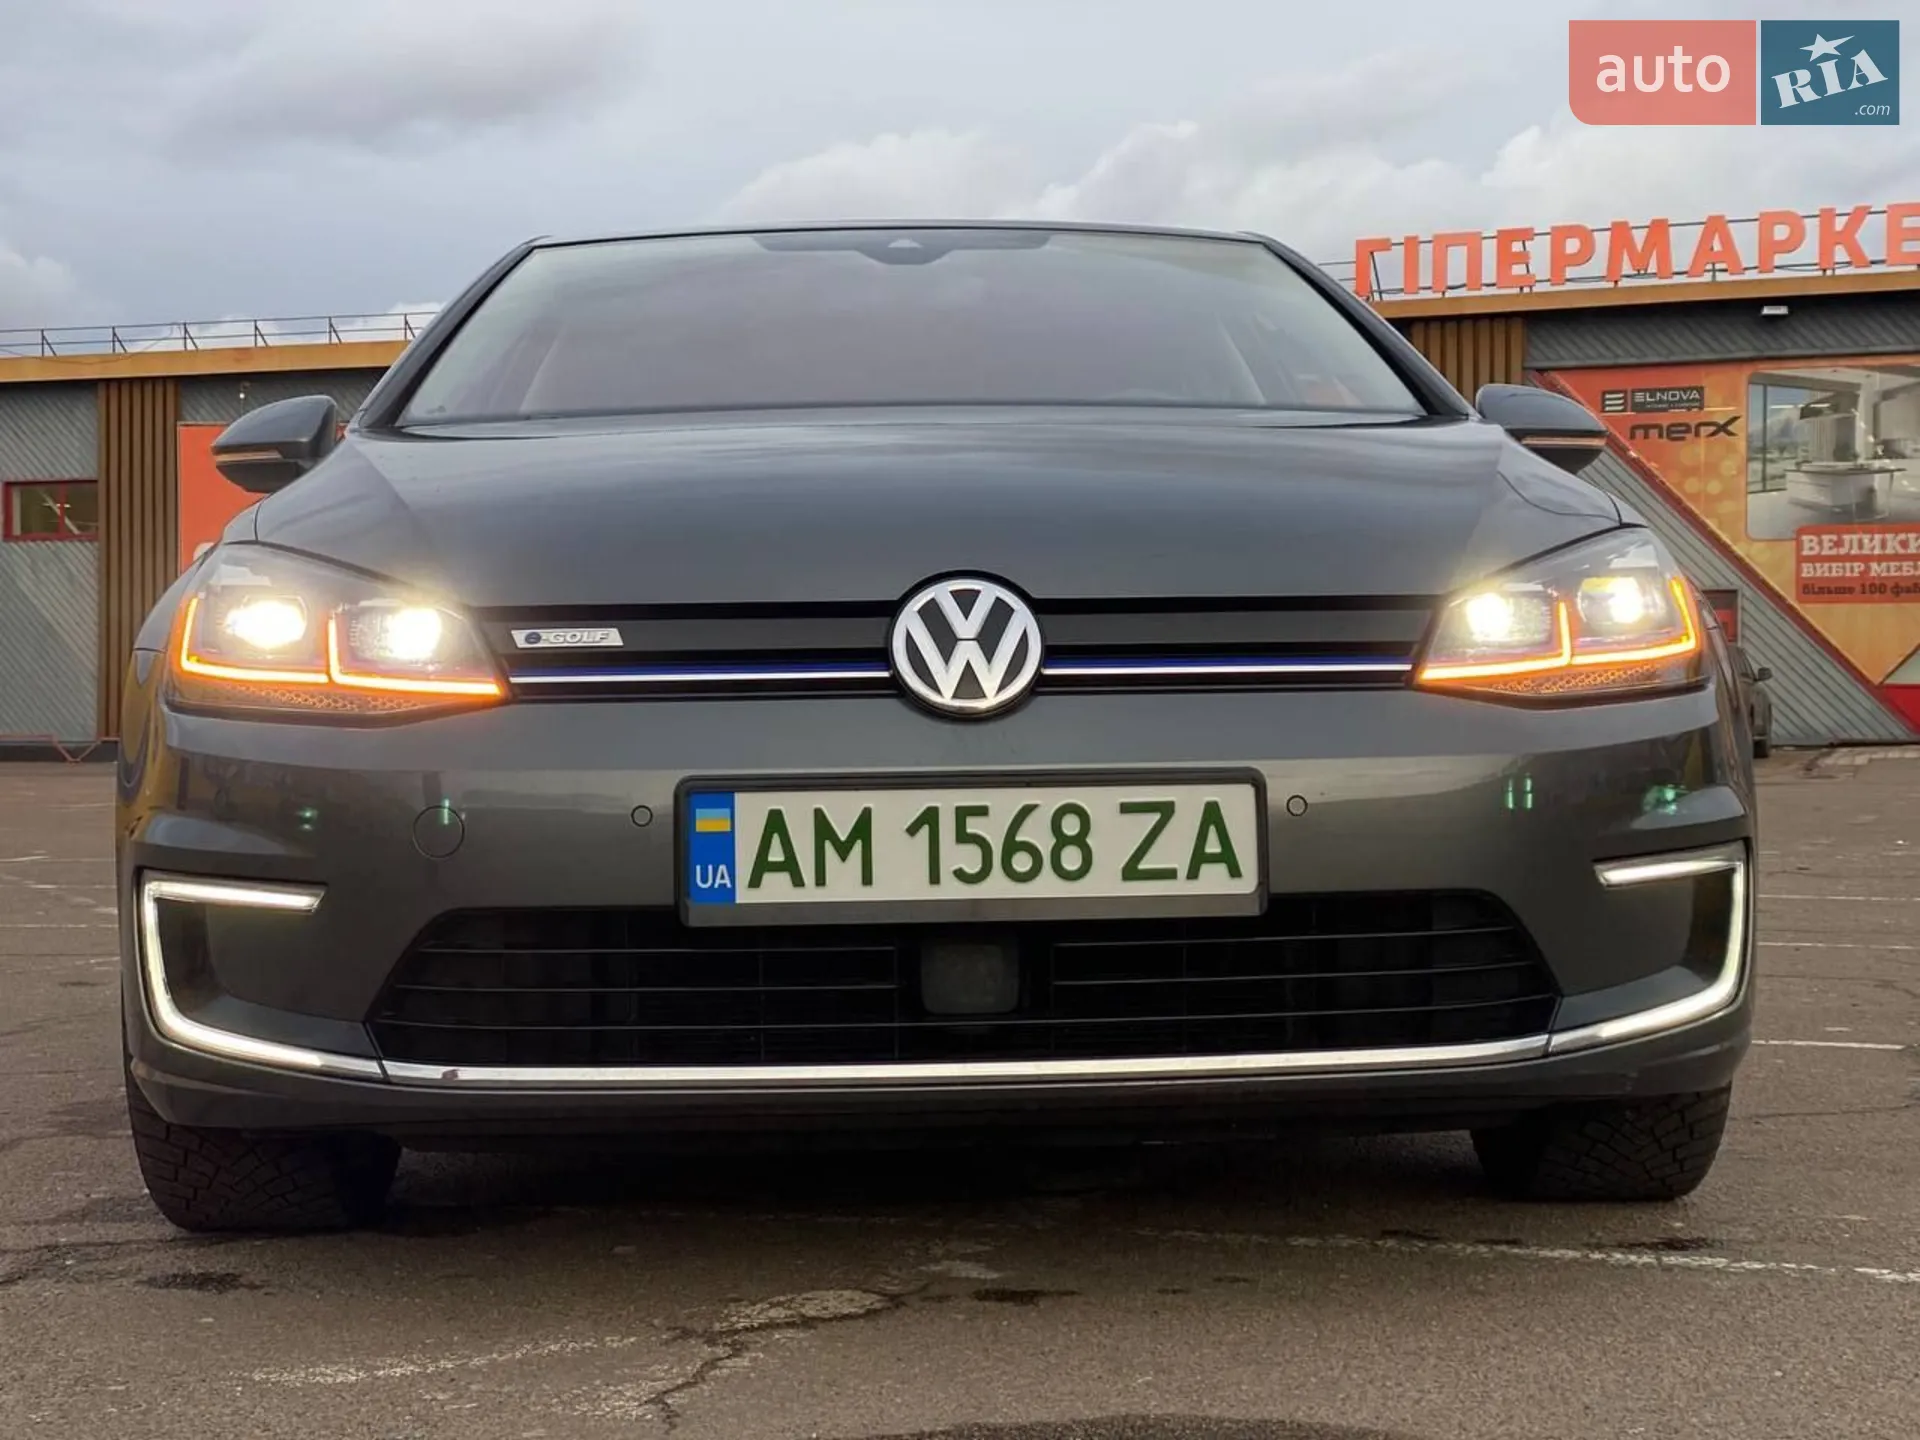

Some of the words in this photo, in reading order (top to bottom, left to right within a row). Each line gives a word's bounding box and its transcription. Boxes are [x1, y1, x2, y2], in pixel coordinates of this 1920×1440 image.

[1355, 202, 1920, 298] ГІПЕРМАРКЕ
[1633, 389, 1701, 403] ELNOVA
[1629, 415, 1742, 440] merx
[1800, 561, 1866, 578] ВИБІР
[1860, 582, 1888, 595] 100
[747, 804, 874, 889] AM
[905, 801, 1094, 886] 1568
[1118, 799, 1244, 882] ZA
[695, 864, 732, 890] UA
